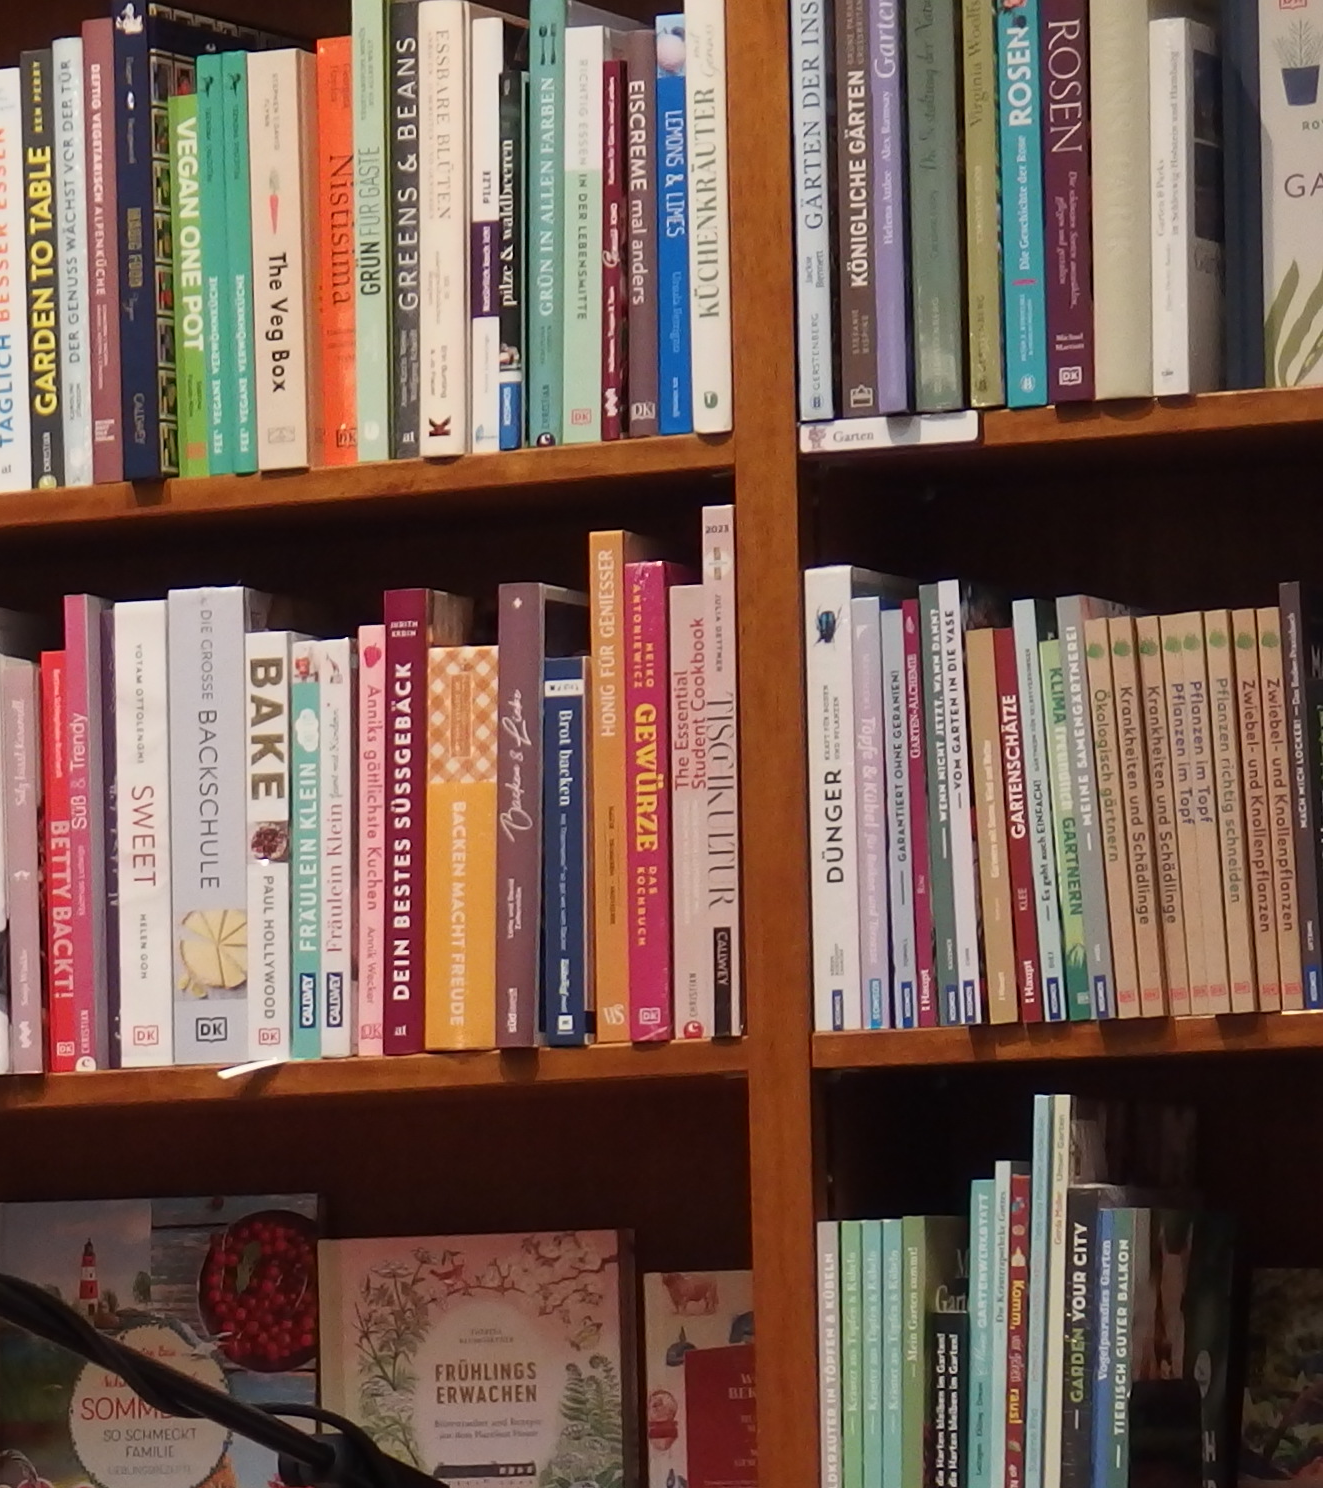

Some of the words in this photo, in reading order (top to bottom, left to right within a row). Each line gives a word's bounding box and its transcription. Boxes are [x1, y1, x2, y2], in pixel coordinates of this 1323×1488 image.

[396, 37, 416, 140] BEANS
[844, 69, 867, 154] GÄRTEN
[1007, 27, 1033, 126] ROSEN
[1048, 19, 1082, 153] ROSEN
[174, 117, 199, 220] VEGAN
[398, 159, 416, 174] &
[628, 79, 647, 191] EISCREME
[665, 110, 683, 166] LEMONS
[27, 145, 52, 235] TABLE
[665, 170, 684, 188] &
[693, 87, 720, 319] KÜCHENKRÄUTER
[329, 154, 354, 305] Nistisima
[398, 187, 418, 310] GREENS
[632, 200, 642, 232] mal
[665, 192, 684, 240] LIMES
[846, 156, 869, 289] KÖNIGLICHE
[30, 241, 54, 279] TO
[179, 227, 201, 288] ONE
[268, 252, 286, 291] The
[632, 238, 643, 305] anders
[32, 285, 57, 416] GARDEN
[181, 293, 204, 352] POT
[267, 299, 289, 340] Veg
[273, 346, 289, 392] Box
[1059, 367, 1082, 384] DK
[833, 429, 874, 443] Garten
[200, 610, 212, 635] DIE
[200, 639, 214, 701] GROSSE
[690, 618, 705, 712] Cookbook
[250, 657, 285, 800] BAKE
[674, 669, 690, 749] Essential
[1121, 686, 1137, 790] Krankheiten
[1190, 681, 1203, 755] Pflanzen
[1267, 678, 1283, 754] Zwiebel-
[389, 663, 412, 827] SÜSSGEBÄCK
[635, 702, 664, 853] GEWÜRZE
[675, 756, 691, 791] The
[692, 717, 707, 792] Student
[1001, 695, 1026, 839] GARTENSCHÄTZE
[1197, 759, 1206, 780] im
[1272, 758, 1287, 789] und
[198, 710, 220, 889] BACKSCHULE
[299, 762, 316, 830] KLEIN
[822, 769, 844, 884] DÜNGER
[1129, 796, 1144, 827] und
[1196, 786, 1213, 822] Topf
[131, 785, 155, 887] SWEET
[1276, 793, 1293, 932] Knollenpflanzen
[264, 876, 273, 917] PAUL
[299, 838, 318, 952] FRÄULEIN
[393, 839, 410, 927] BESTES
[1132, 830, 1148, 925] Schädlinge
[264, 919, 275, 1018] HOLLYWOOD
[393, 939, 410, 1000] DEIN
[1073, 1222, 1088, 1267] CITY
[1119, 1239, 1129, 1302] BALKON
[1072, 1271, 1087, 1325] YOUR
[1116, 1306, 1128, 1357] GUTER
[434, 1359, 536, 1381] FRÜHLINGS
[436, 1384, 537, 1405] ERWACHEN
[1071, 1328, 1085, 1404] GARDEN
[1114, 1362, 1130, 1435] TIERISCH
[103, 1429, 120, 1442] SO
[126, 1428, 196, 1442] SCHMECKT
[126, 1445, 174, 1458] FAMILIE
